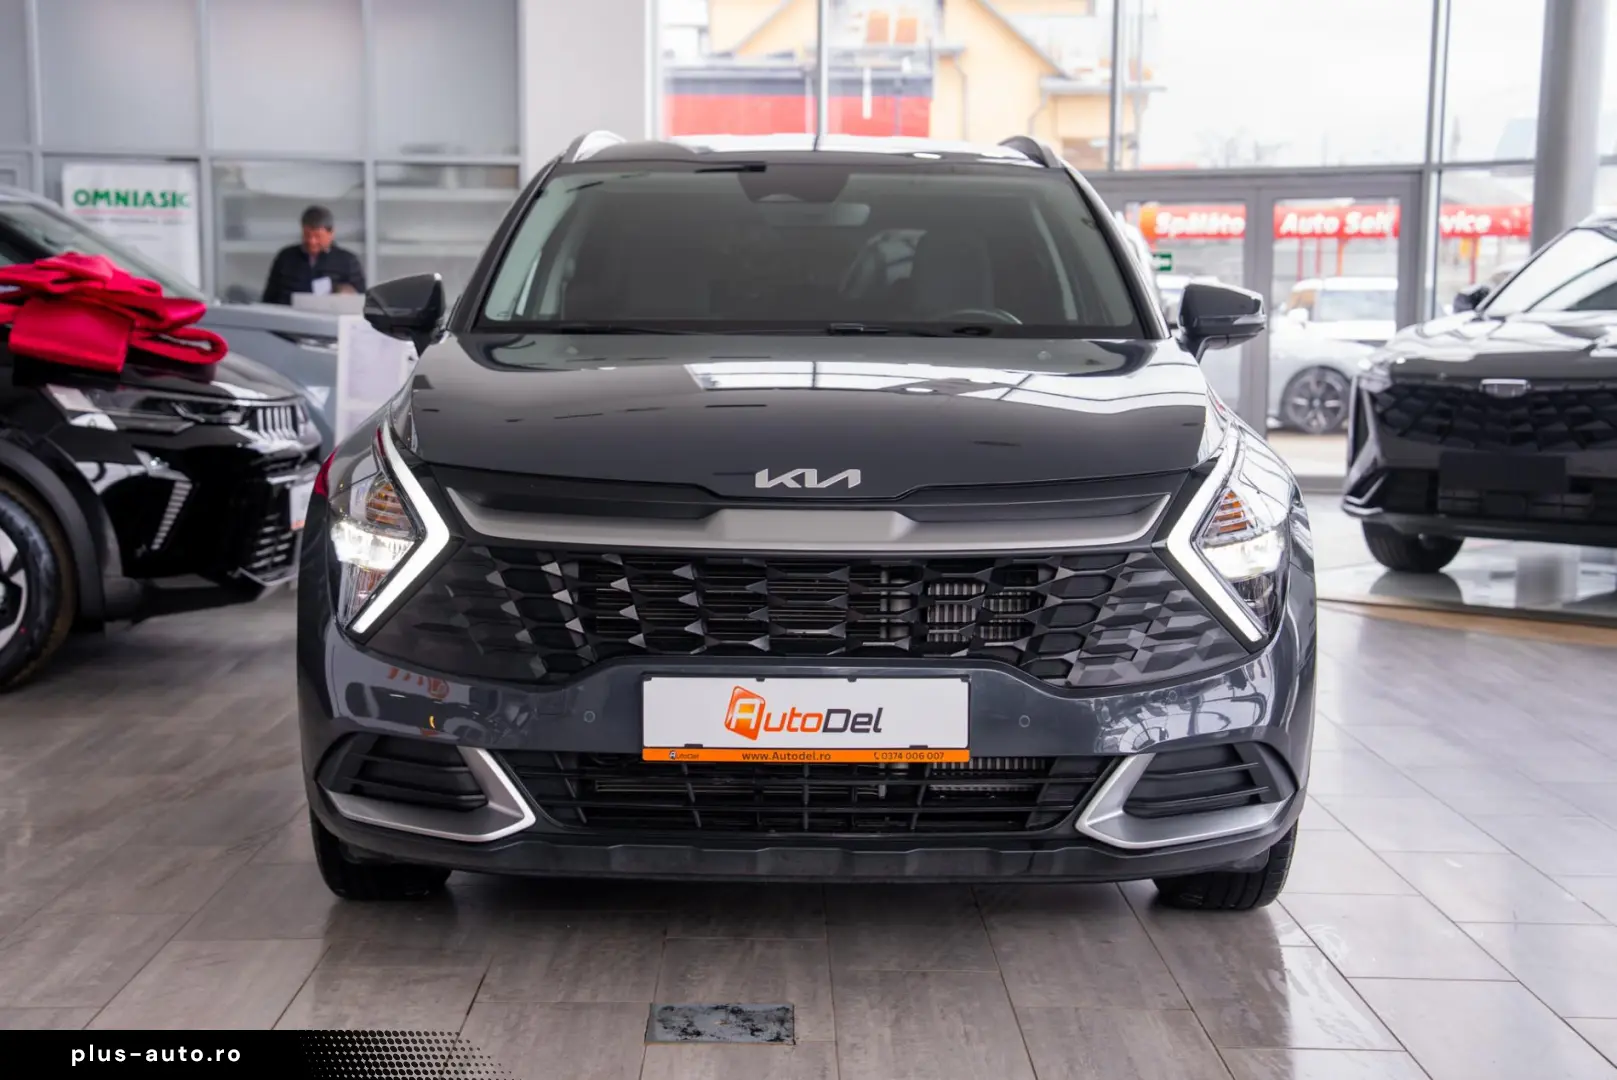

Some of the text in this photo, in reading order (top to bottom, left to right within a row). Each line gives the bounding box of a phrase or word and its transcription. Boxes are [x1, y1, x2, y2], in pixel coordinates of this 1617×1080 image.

[1280, 212, 1339, 234] Auto
[1439, 211, 1491, 233] vice
[755, 468, 861, 489] KIA
[727, 693, 884, 736] AutoDel
[741, 751, 832, 761] www.Autodel.ro
[881, 751, 945, 760] 0374 006 007
